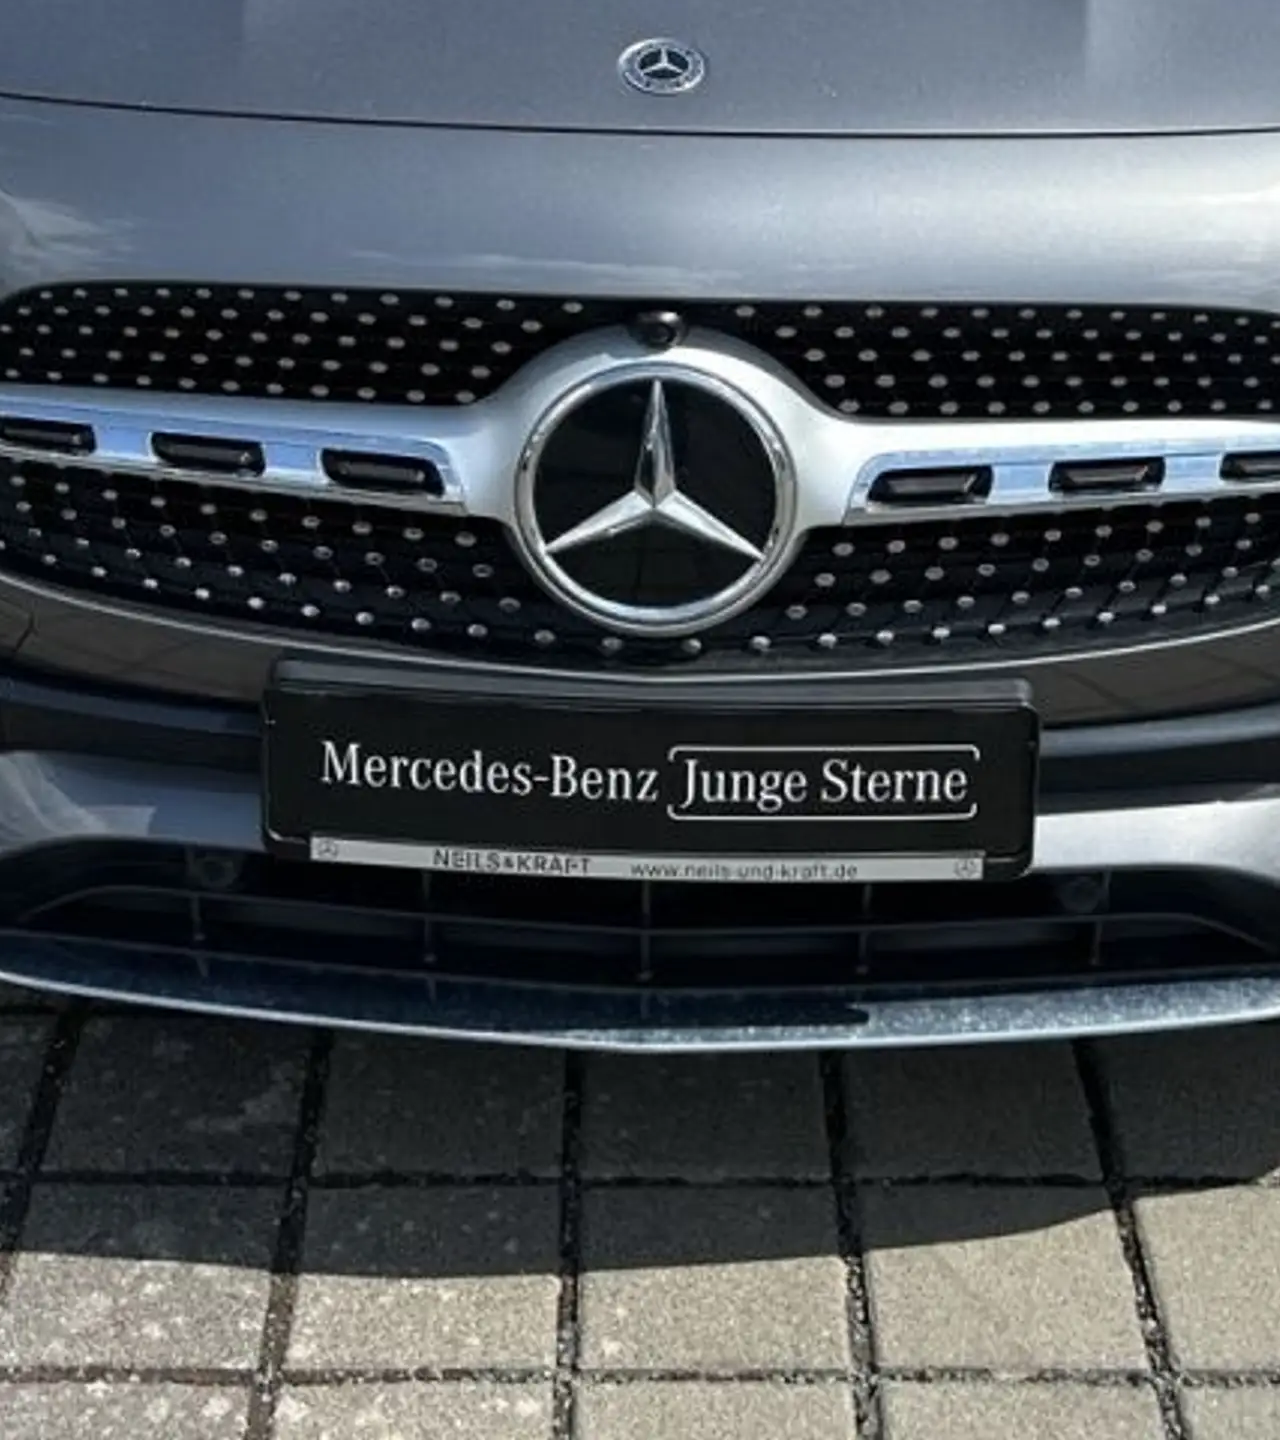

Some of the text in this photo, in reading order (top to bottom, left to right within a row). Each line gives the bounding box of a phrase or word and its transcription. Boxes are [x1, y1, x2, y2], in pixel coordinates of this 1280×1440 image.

[321, 740, 969, 813] Mercedes-Benz Junge Sterne
[433, 848, 859, 882] NEILS&KRAFT www.neils-und-kraft.de
